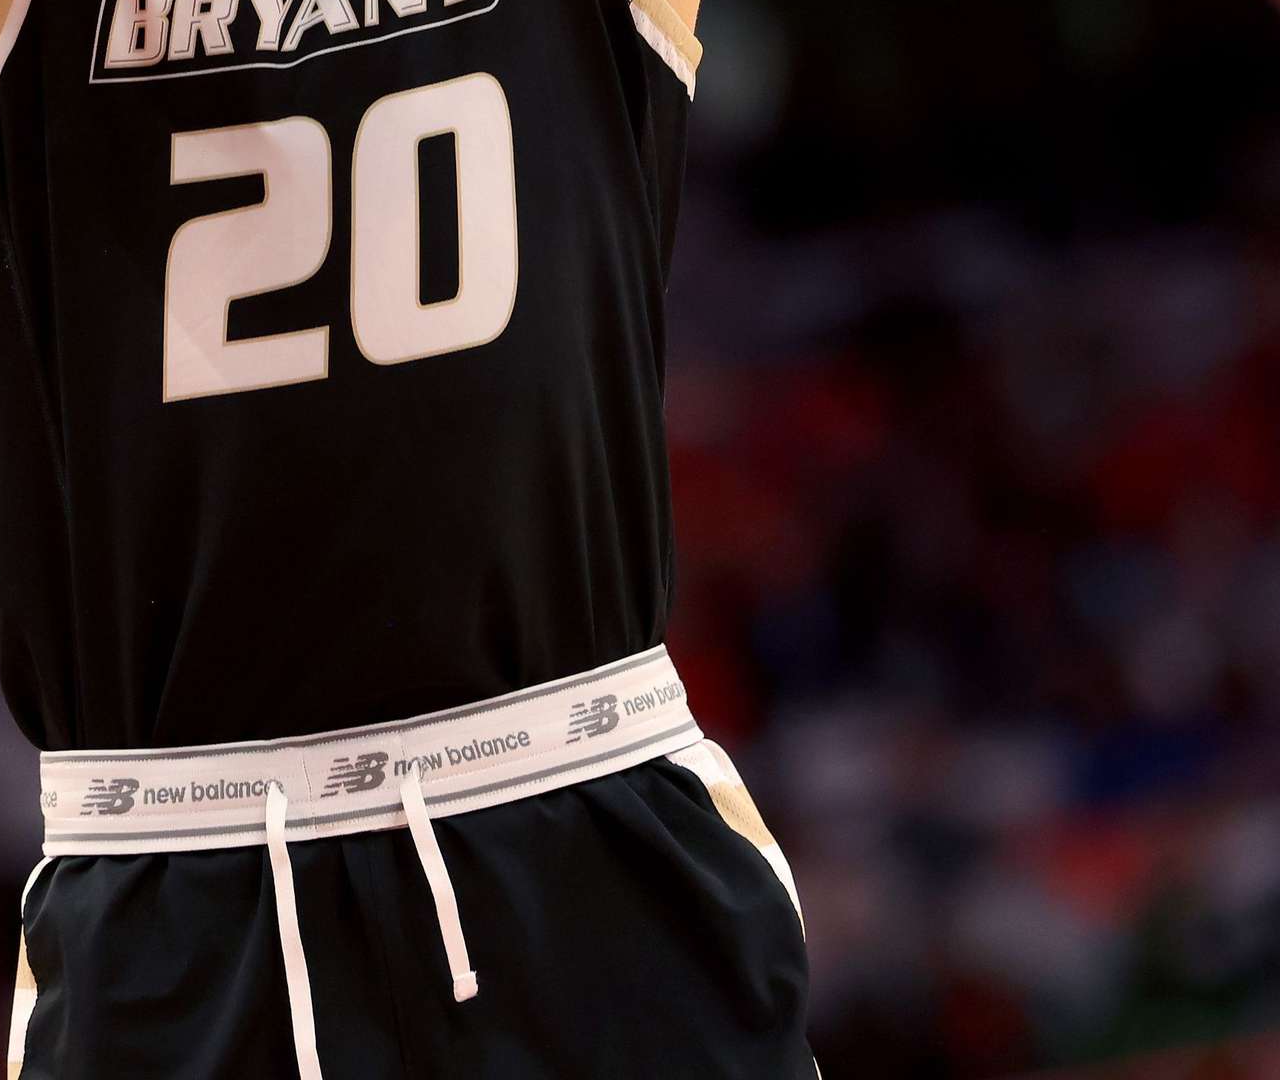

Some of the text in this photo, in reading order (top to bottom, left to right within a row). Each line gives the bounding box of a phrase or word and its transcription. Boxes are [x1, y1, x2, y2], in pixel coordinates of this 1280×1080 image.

[163, 72, 518, 403] 20
[623, 688, 656, 716] new
[444, 730, 531, 766] balance
[143, 785, 186, 805] new
